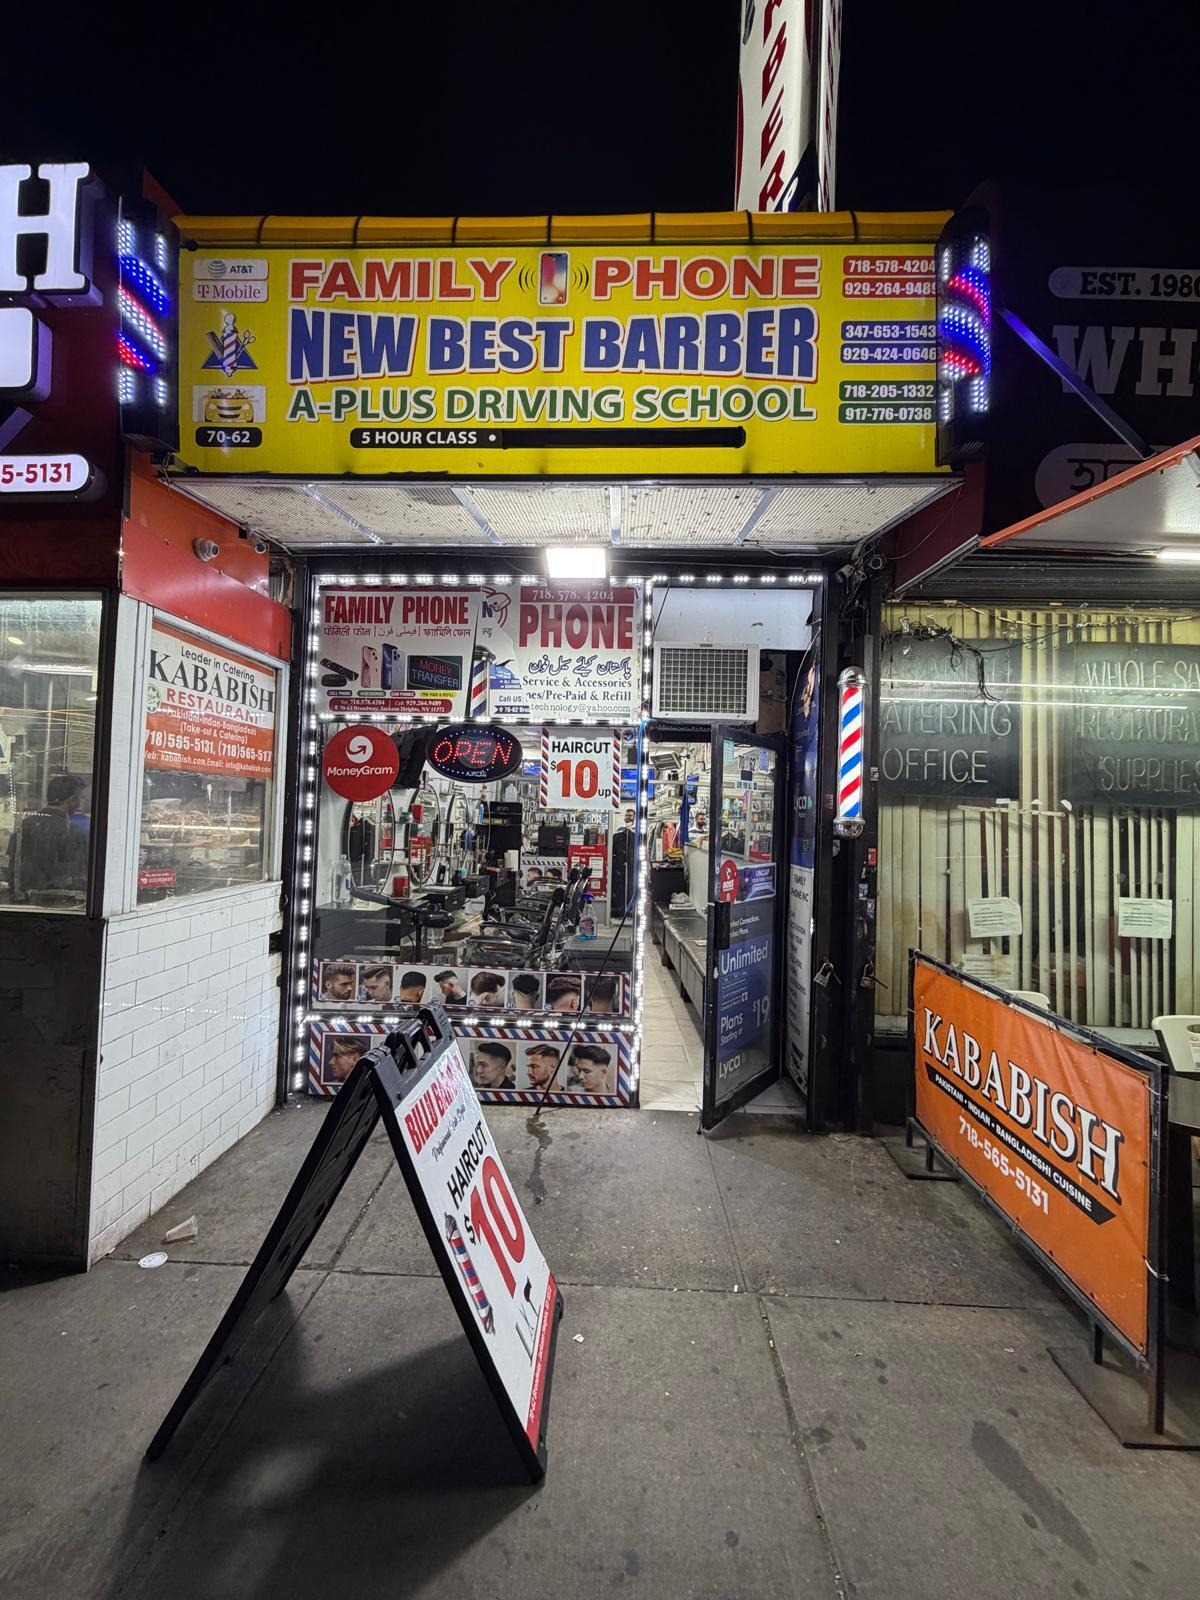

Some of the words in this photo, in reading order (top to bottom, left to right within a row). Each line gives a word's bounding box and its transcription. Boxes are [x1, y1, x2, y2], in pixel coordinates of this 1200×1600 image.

[230, 265, 254, 274] AT&T
[848, 259, 936, 273] 718-578-4204
[290, 259, 515, 300] FAMILY
[593, 257, 820, 299] PHONE
[1079, 272, 1142, 295] EST.
[845, 324, 937, 338] 347-653-1543
[289, 307, 418, 381] NEW
[428, 317, 572, 371] BEST
[582, 306, 818, 380] BARBER
[842, 347, 937, 360] 929-424-0646
[844, 385, 934, 398] 718-205-1332
[288, 388, 435, 420] A-PLUS
[446, 387, 623, 420] DRIVING
[634, 387, 816, 419] SCHOOL
[845, 407, 932, 420] 917-776-0738
[207, 430, 250, 443] 70-62
[361, 431, 370, 444] 5
[375, 431, 422, 444] HOUR
[426, 431, 477, 444] CLASS
[584, 590, 615, 602] 4204
[324, 595, 395, 624] FAMILY
[402, 596, 469, 624] PHONE
[519, 604, 634, 650] PHONE
[181, 646, 211, 665] Leader
[213, 660, 220, 670] in
[223, 662, 255, 683] Catering
[420, 660, 453, 676] MONEY
[149, 649, 275, 713] KABABISH
[412, 668, 459, 687] TRANSFER
[522, 675, 559, 687] Service
[562, 677, 571, 687] &
[575, 677, 632, 688] Accessories
[590, 690, 599, 700] &
[603, 690, 631, 701] Refill
[433, 739, 513, 766] OPEN
[551, 740, 611, 754] HAIRCUT
[882, 748, 989, 784] OFFICE
[598, 787, 611, 799] up
[721, 940, 769, 974] Unlimited
[720, 1012, 744, 1034] Plans
[752, 995, 770, 1028] $19
[720, 1031, 738, 1046] Starting
[737, 1027, 743, 1036] at
[719, 1054, 741, 1080] Lyca
[923, 1007, 1125, 1205] KABABISH
[404, 1089, 439, 1156] BILLU
[935, 1074, 964, 1103] PAKISTANI
[967, 1101, 991, 1127] INDIAN
[995, 1124, 1052, 1178] BANGLADESHI
[1052, 1171, 1093, 1212] CUISINE
[446, 1120, 489, 1211] HAIRCUT
[958, 1116, 1049, 1216] 718-565-5131
